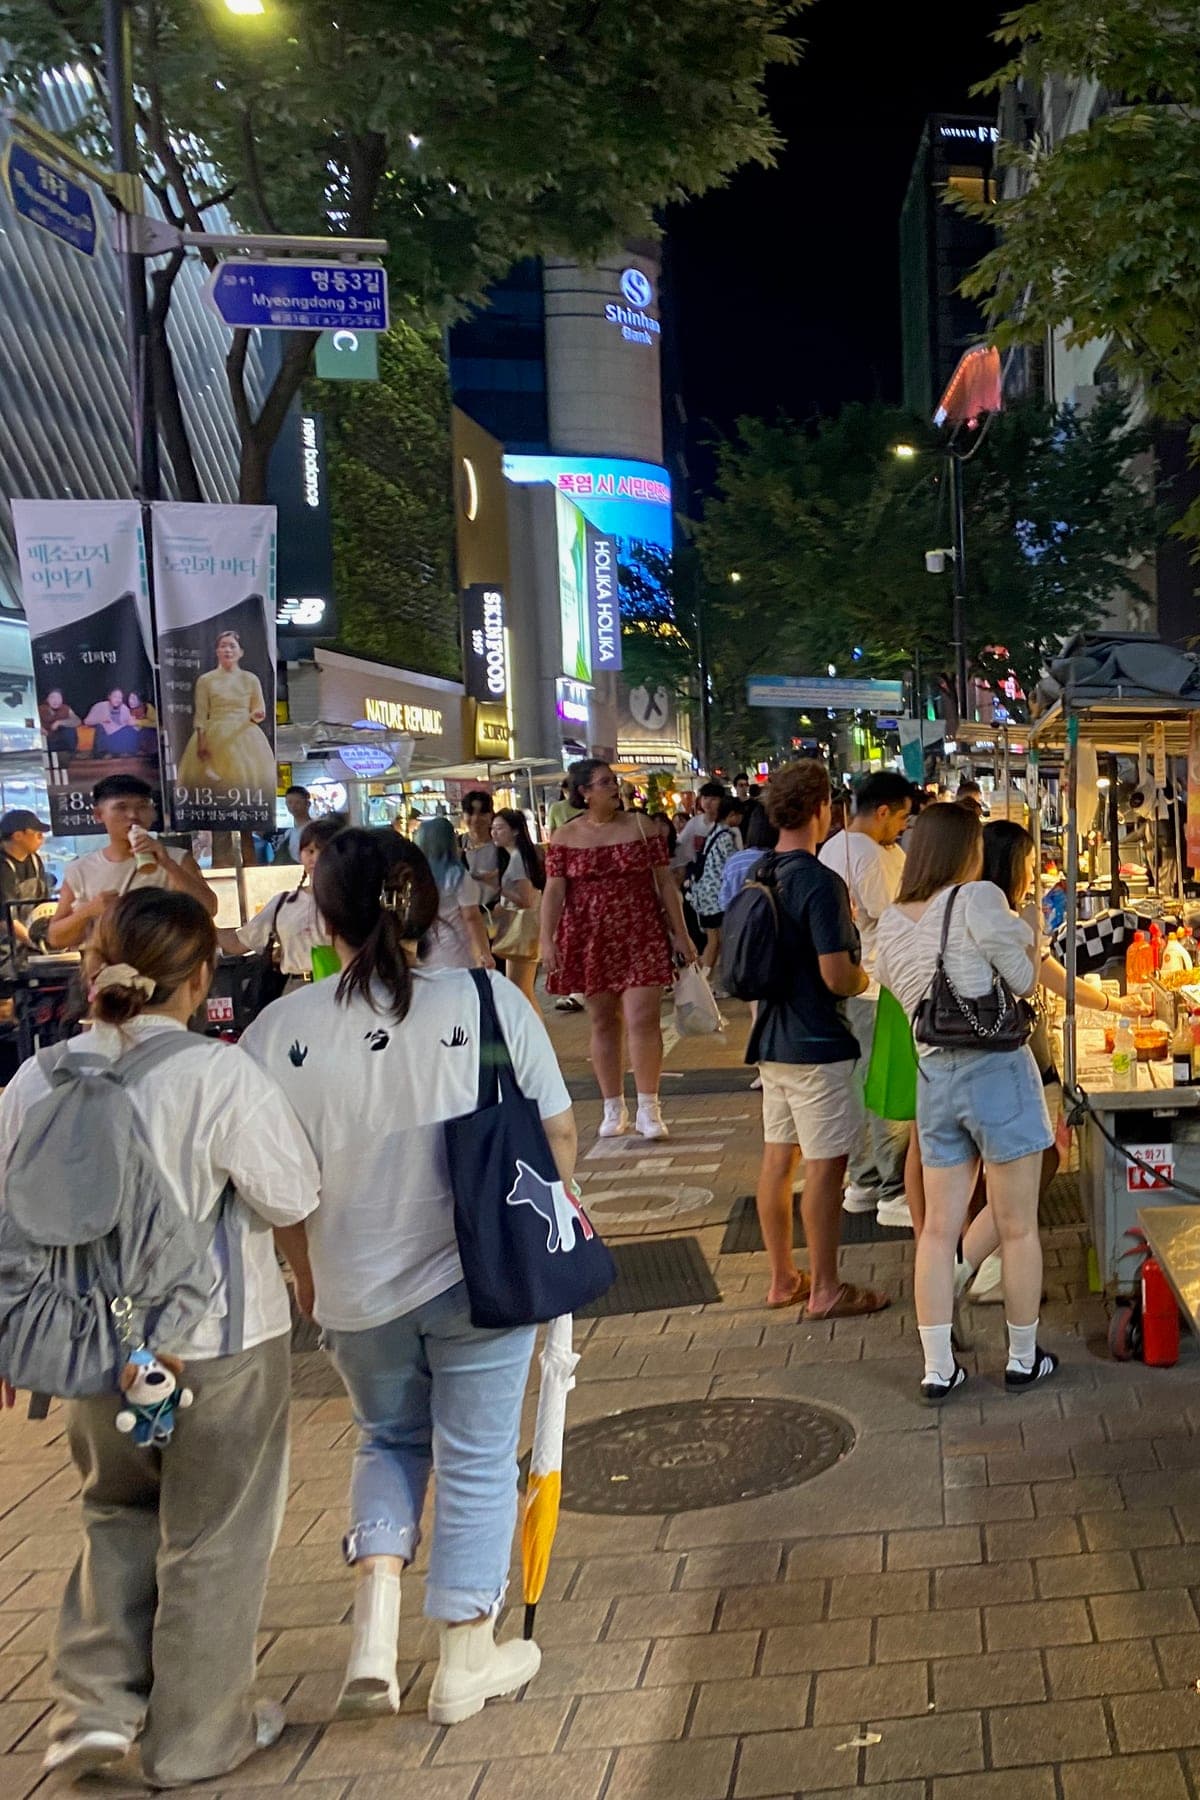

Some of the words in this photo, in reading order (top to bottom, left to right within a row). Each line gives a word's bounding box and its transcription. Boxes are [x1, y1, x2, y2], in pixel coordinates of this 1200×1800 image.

[311, 271, 380, 293] 명동3길
[252, 293, 345, 312] Myeongdong
[349, 297, 381, 312] 3-gil
[622, 325, 653, 346] Bank
[301, 418, 316, 448] new
[304, 448, 320, 507] balance
[557, 473, 593, 494] 폭염
[597, 474, 613, 495] 시
[31, 567, 92, 589] 이야기
[220, 557, 257, 577] 바다
[594, 540, 613, 601] HOLIKA
[483, 591, 506, 694] SKINFOOD
[596, 602, 615, 663] HOLIKA
[365, 698, 404, 730] NATURE
[404, 704, 443, 735] REPUBLIC
[1133, 1148, 1167, 1163] 소화기
